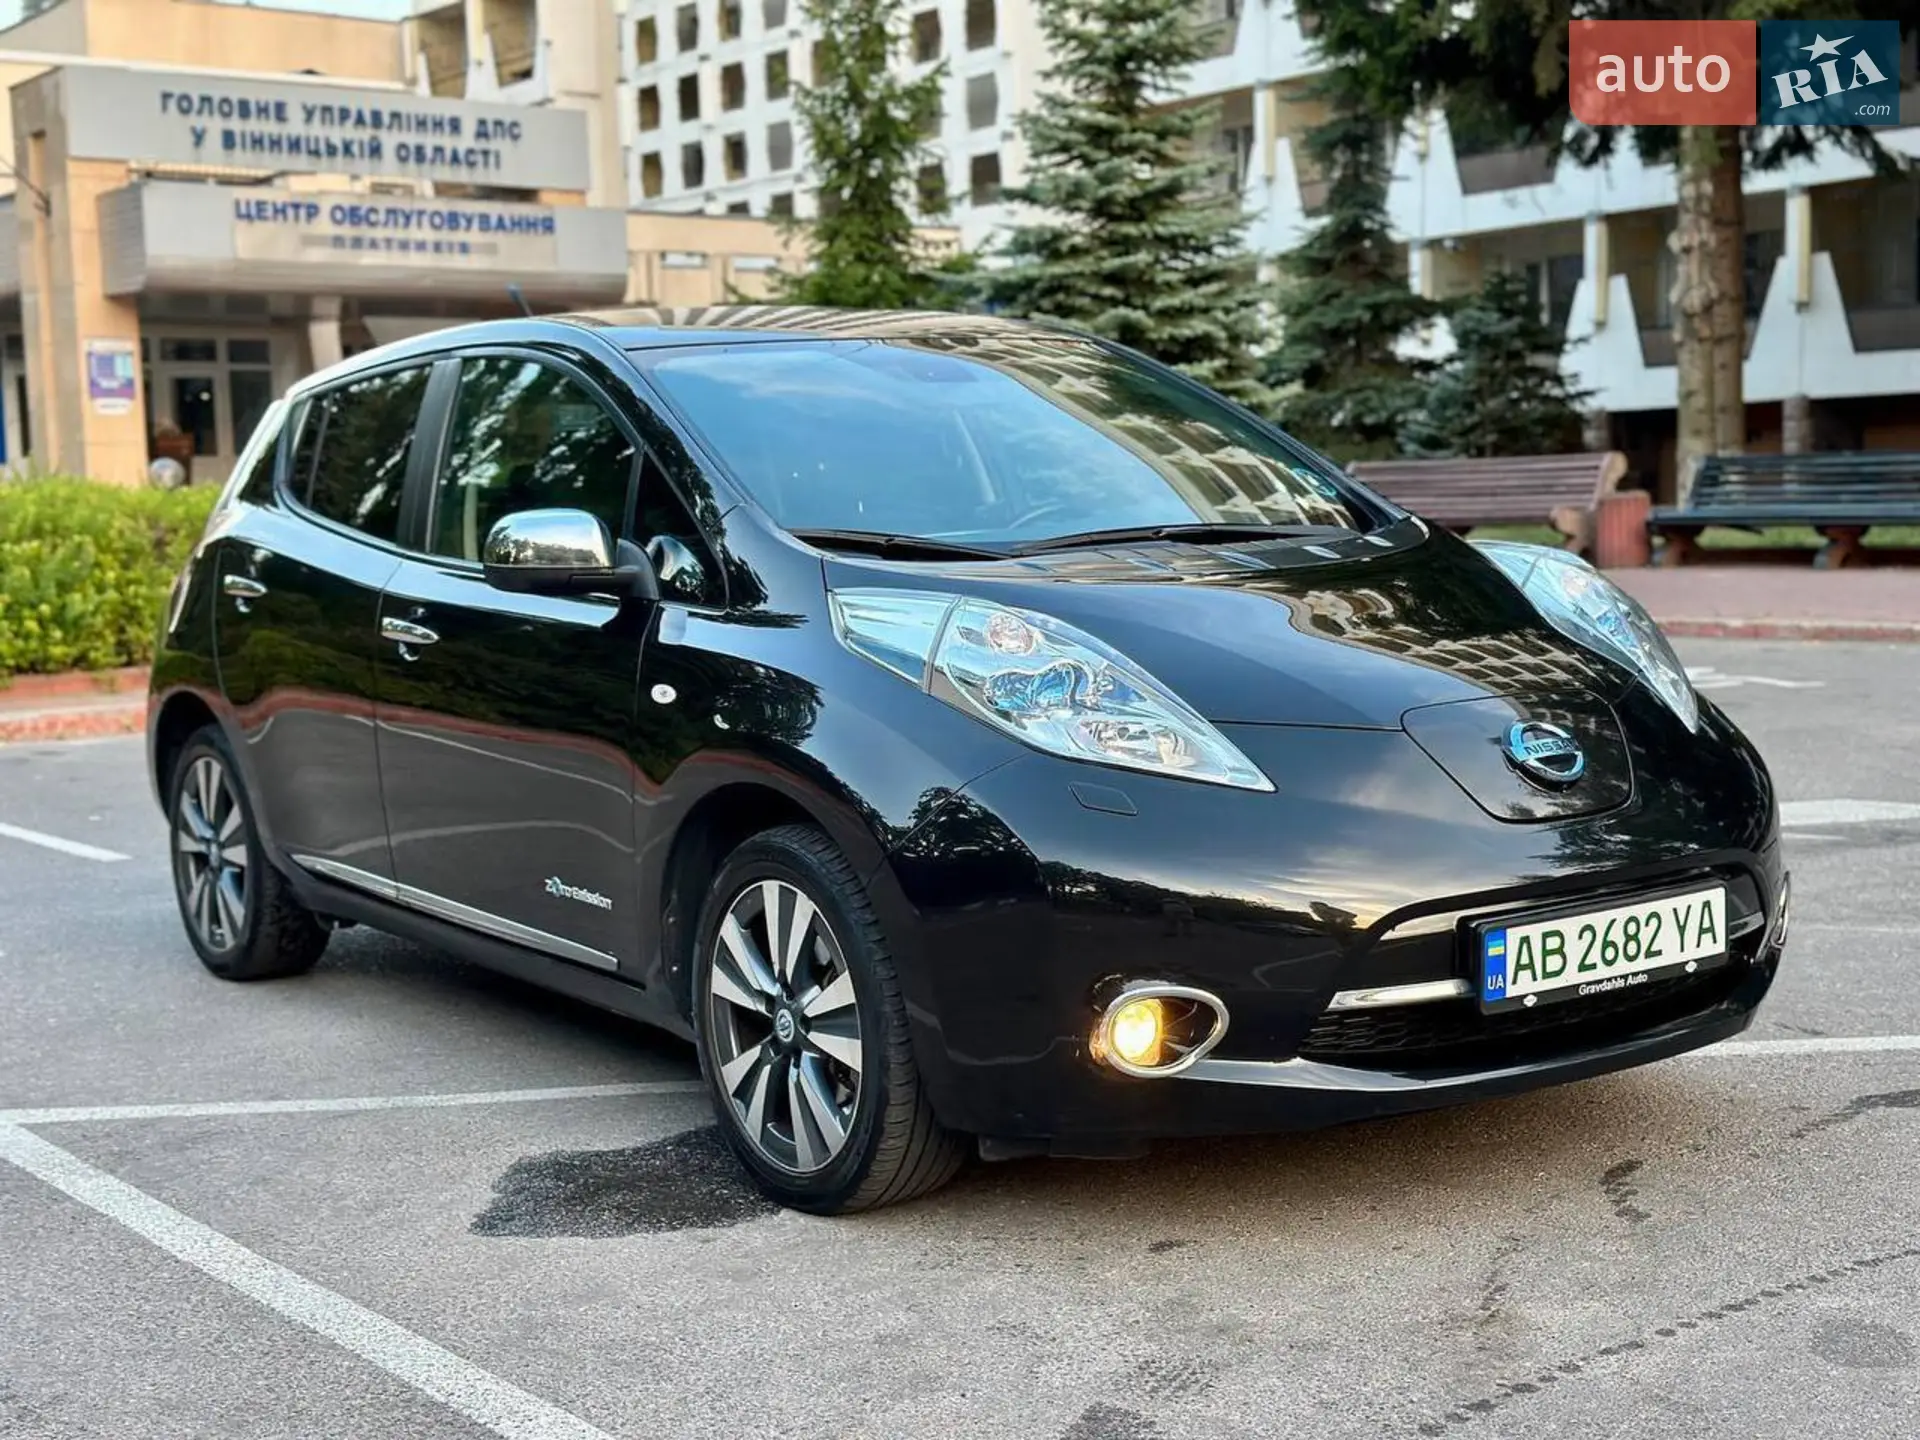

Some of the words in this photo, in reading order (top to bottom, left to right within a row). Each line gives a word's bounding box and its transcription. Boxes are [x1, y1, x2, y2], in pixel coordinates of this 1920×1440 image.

[161, 91, 288, 122] ГОЛОВНЕ
[303, 103, 461, 136] УПРАВЛІННЯ
[475, 118, 522, 142] ДПС
[191, 126, 206, 148] У
[222, 129, 383, 160] ВІННИЦЬКІЙ
[396, 142, 501, 170] ОБЛАСТІ
[234, 199, 320, 224] ЦЕНТР
[330, 204, 555, 235] ОБСЛУГОВУВАННЯ
[1511, 929, 1568, 986] AB
[1577, 911, 1663, 973] 2682
[1673, 900, 1717, 953] YA
[1487, 974, 1505, 990] UA
[1579, 978, 1625, 996] Gravdahls
[1627, 973, 1648, 986] Auto
